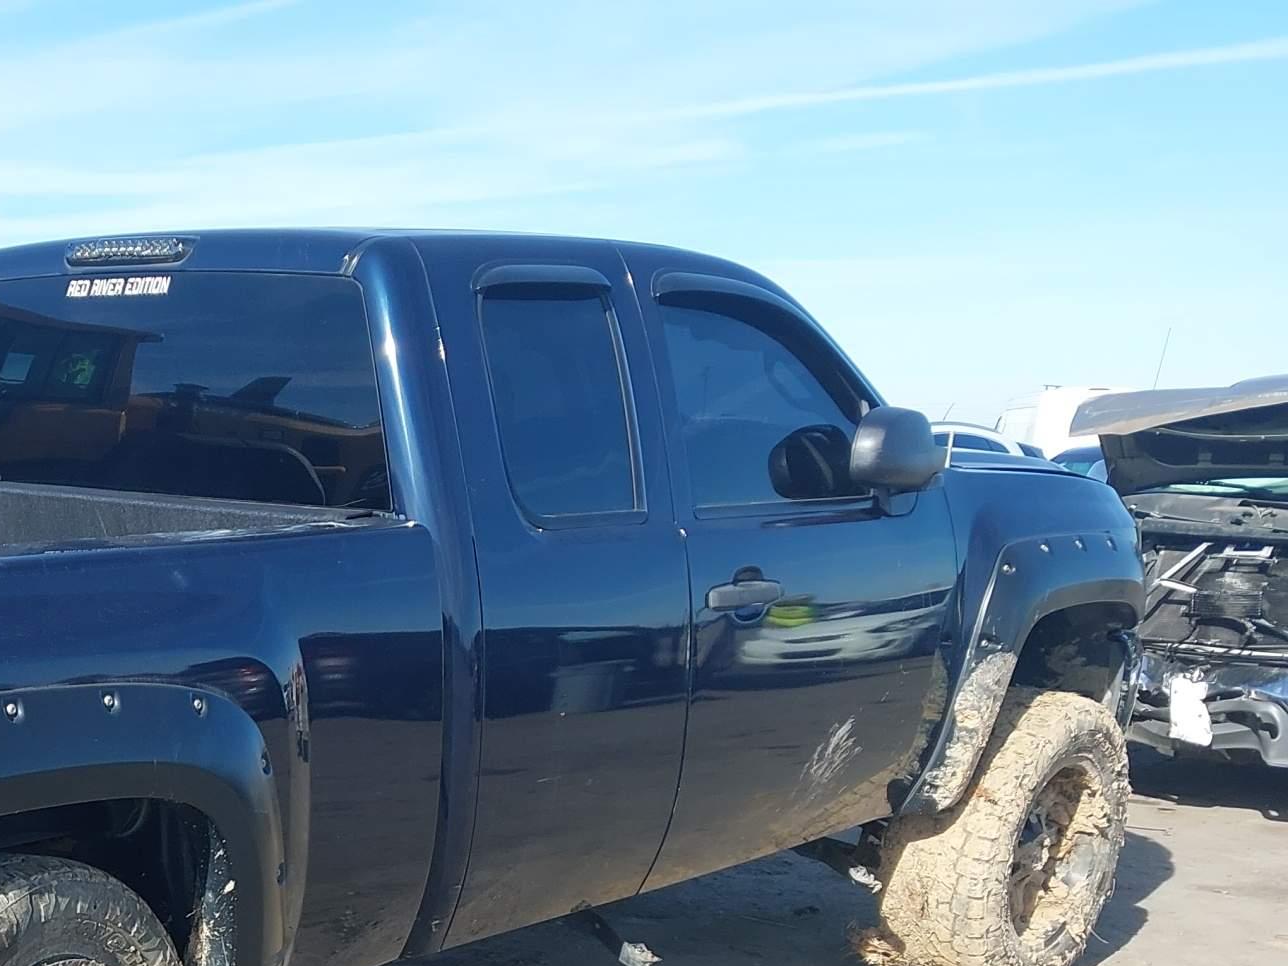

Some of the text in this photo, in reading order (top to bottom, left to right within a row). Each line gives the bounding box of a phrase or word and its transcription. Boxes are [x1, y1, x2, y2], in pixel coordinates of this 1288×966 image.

[66, 275, 172, 297] RED RIVER EDITION
